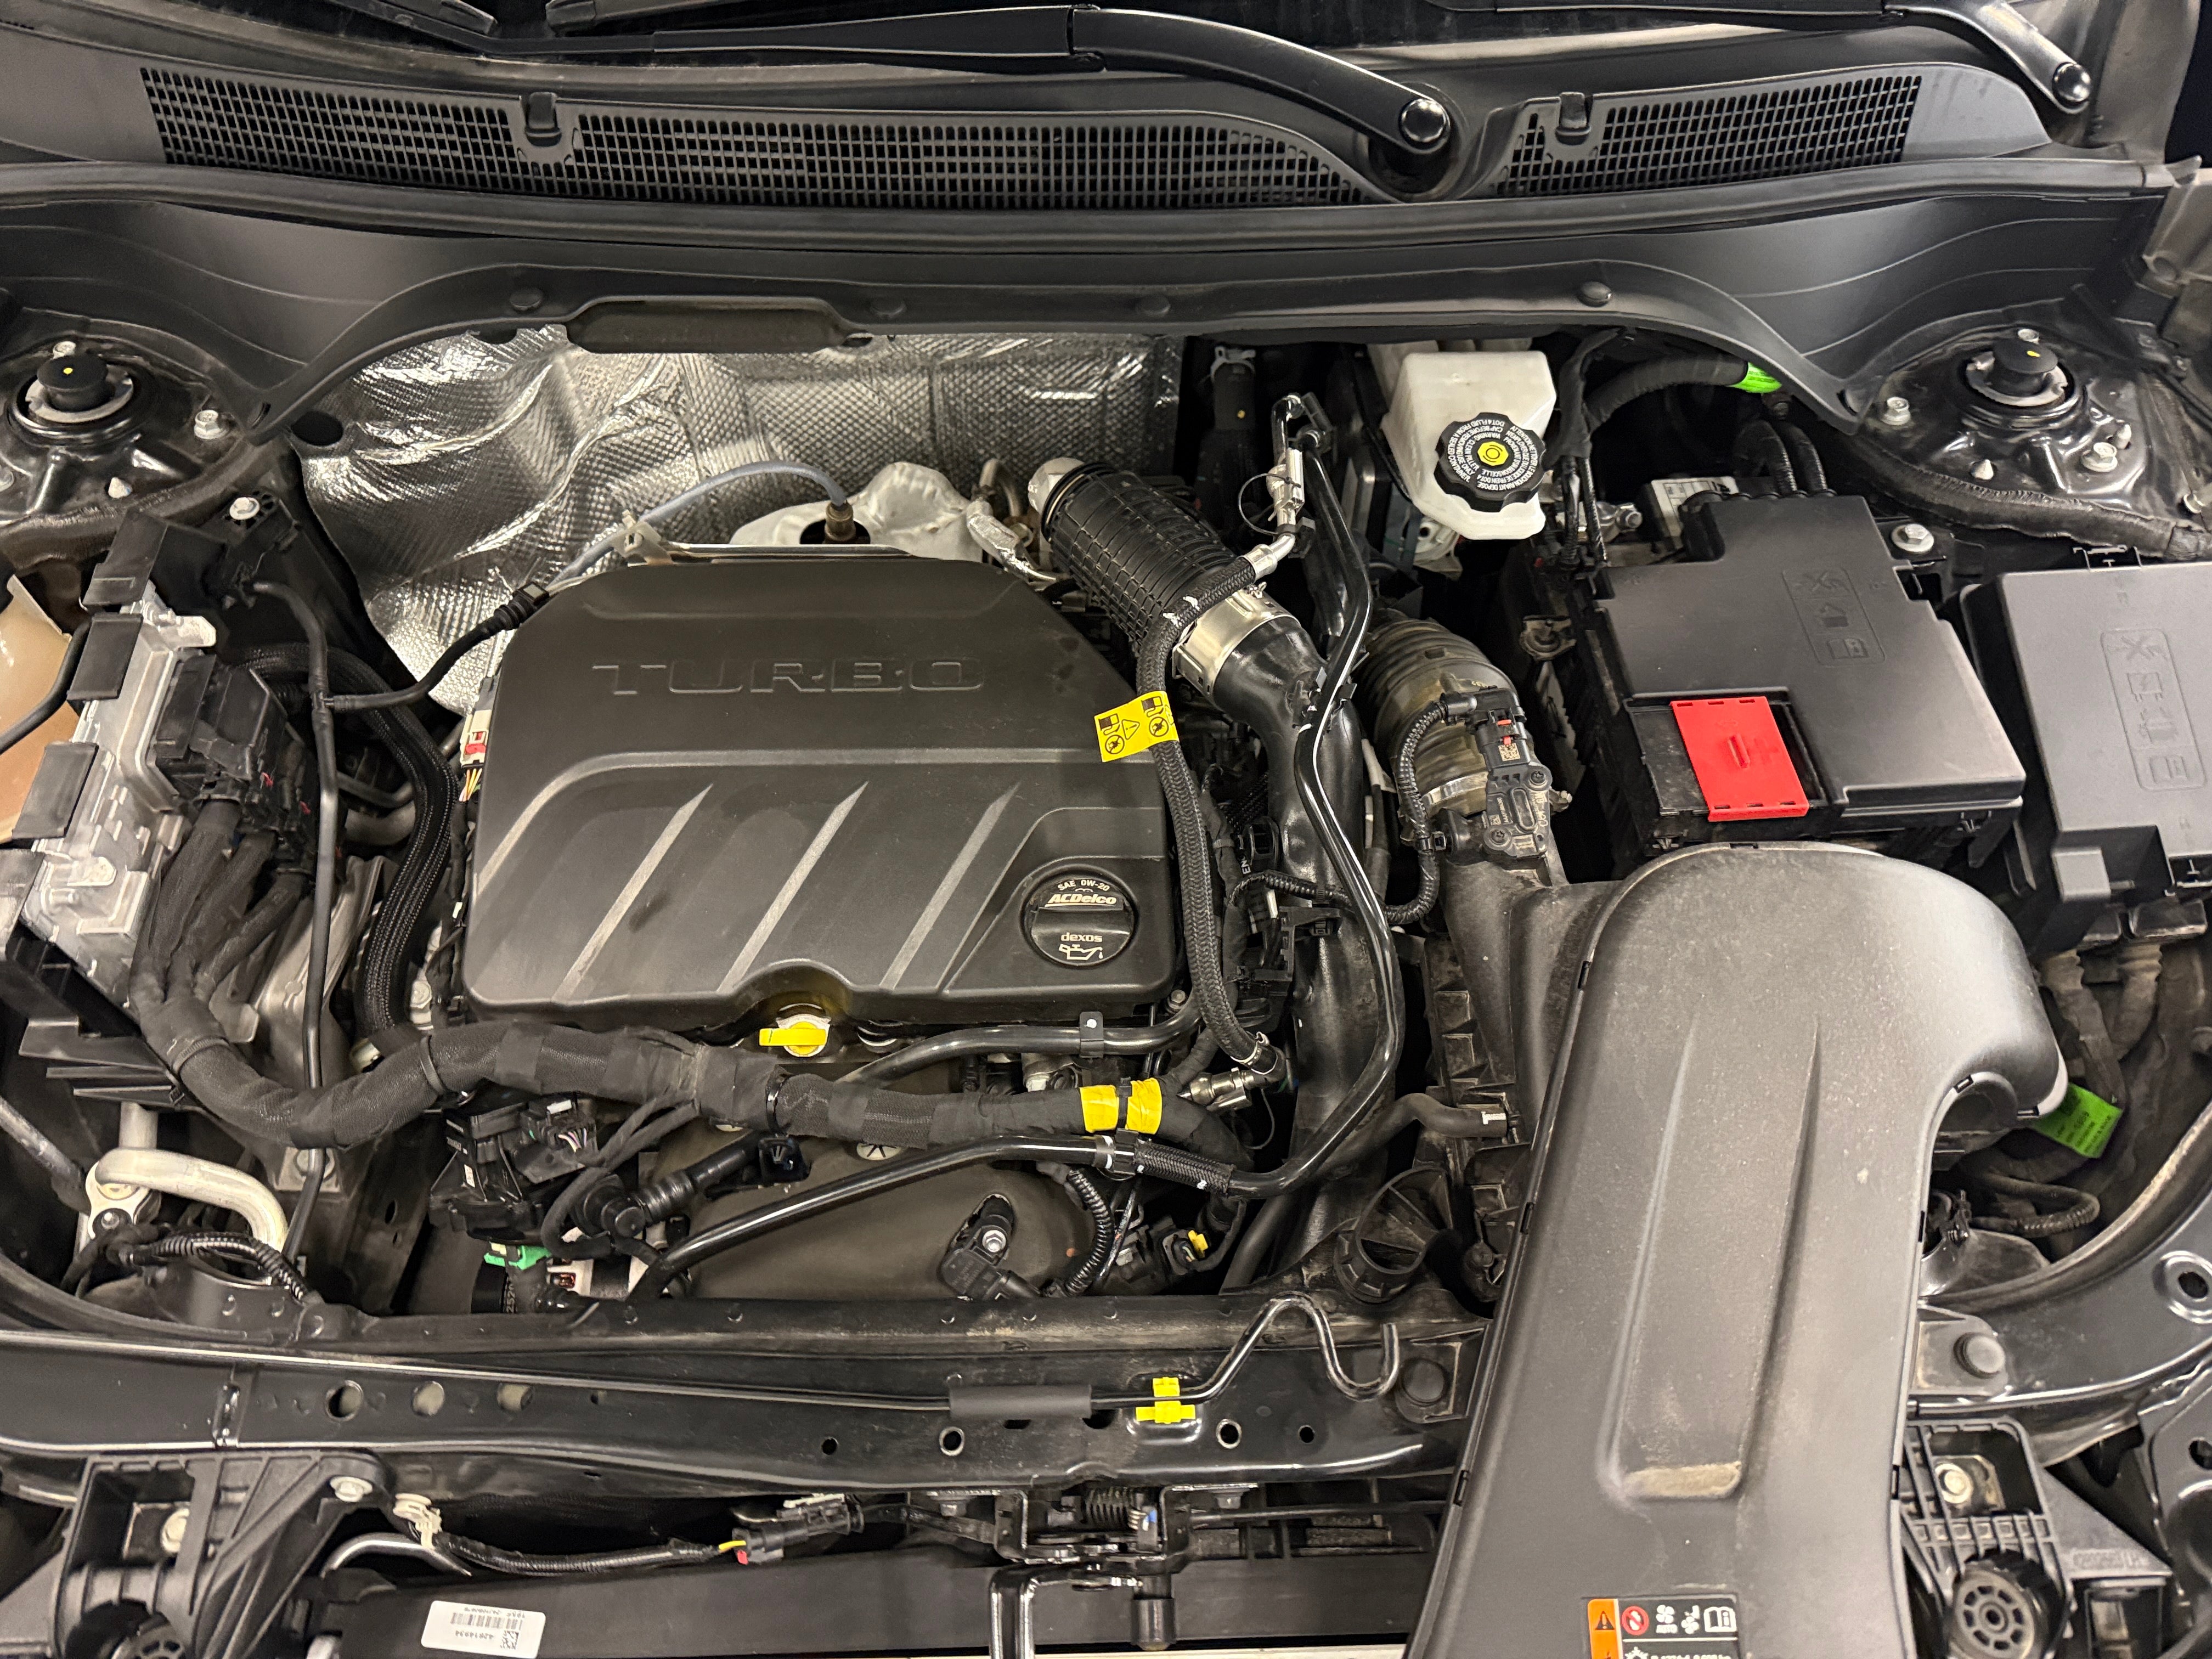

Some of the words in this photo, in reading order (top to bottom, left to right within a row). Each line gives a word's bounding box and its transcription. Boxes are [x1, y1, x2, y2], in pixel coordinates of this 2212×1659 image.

[1455, 423, 1472, 435] FROM
[1466, 426, 1489, 436] BEFORE
[1447, 436, 1458, 455] SEALED
[1464, 439, 1476, 455] CLEAN
[1456, 454, 1465, 464] USE
[1465, 455, 1480, 471] FILLER
[1460, 463, 1475, 476] ONLY
[1498, 482, 1516, 490] AVANT
[592, 658, 985, 696] TURBO
[1057, 880, 1076, 891] SAE
[1080, 879, 1110, 892] 0W-20
[1047, 893, 1117, 905] ACDelco
[1060, 932, 1103, 943] dexos
